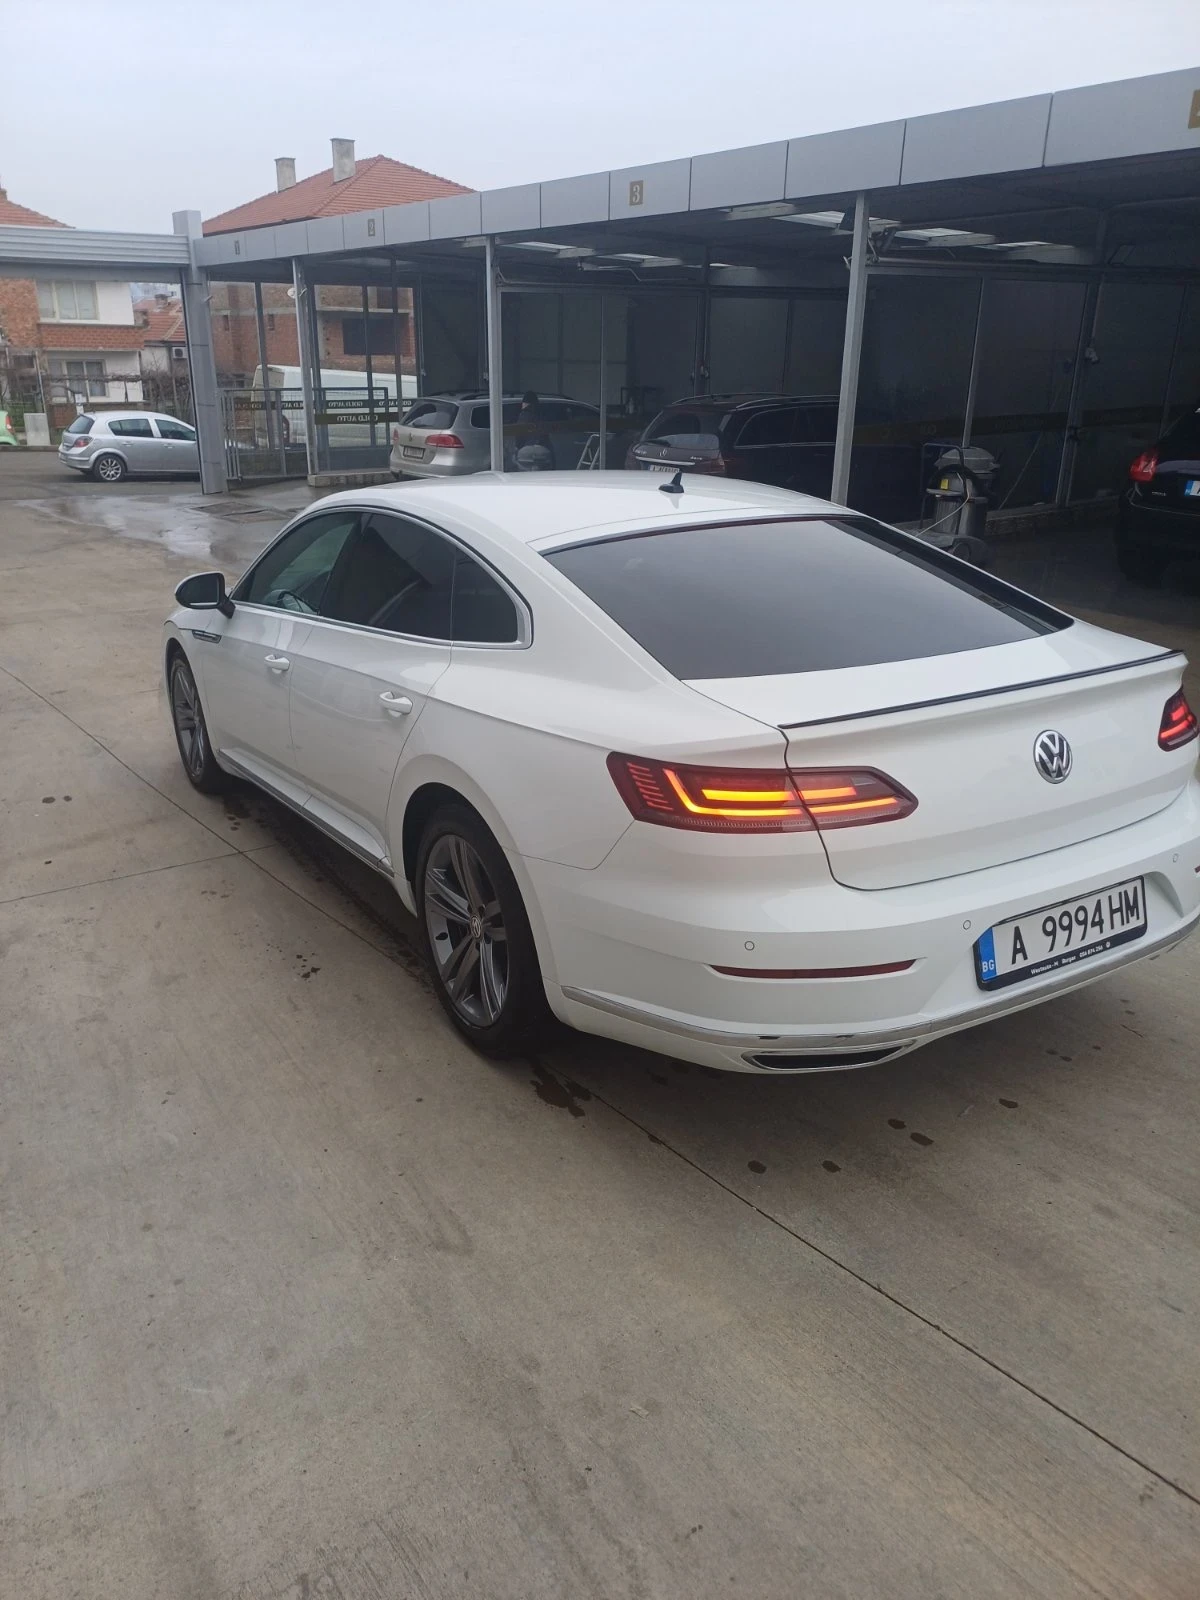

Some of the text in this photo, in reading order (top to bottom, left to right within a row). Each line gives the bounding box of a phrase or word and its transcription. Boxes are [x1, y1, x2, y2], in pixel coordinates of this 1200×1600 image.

[632, 184, 640, 203] 3
[1011, 886, 1140, 965] A 9994 HM
[981, 959, 996, 973] BG
